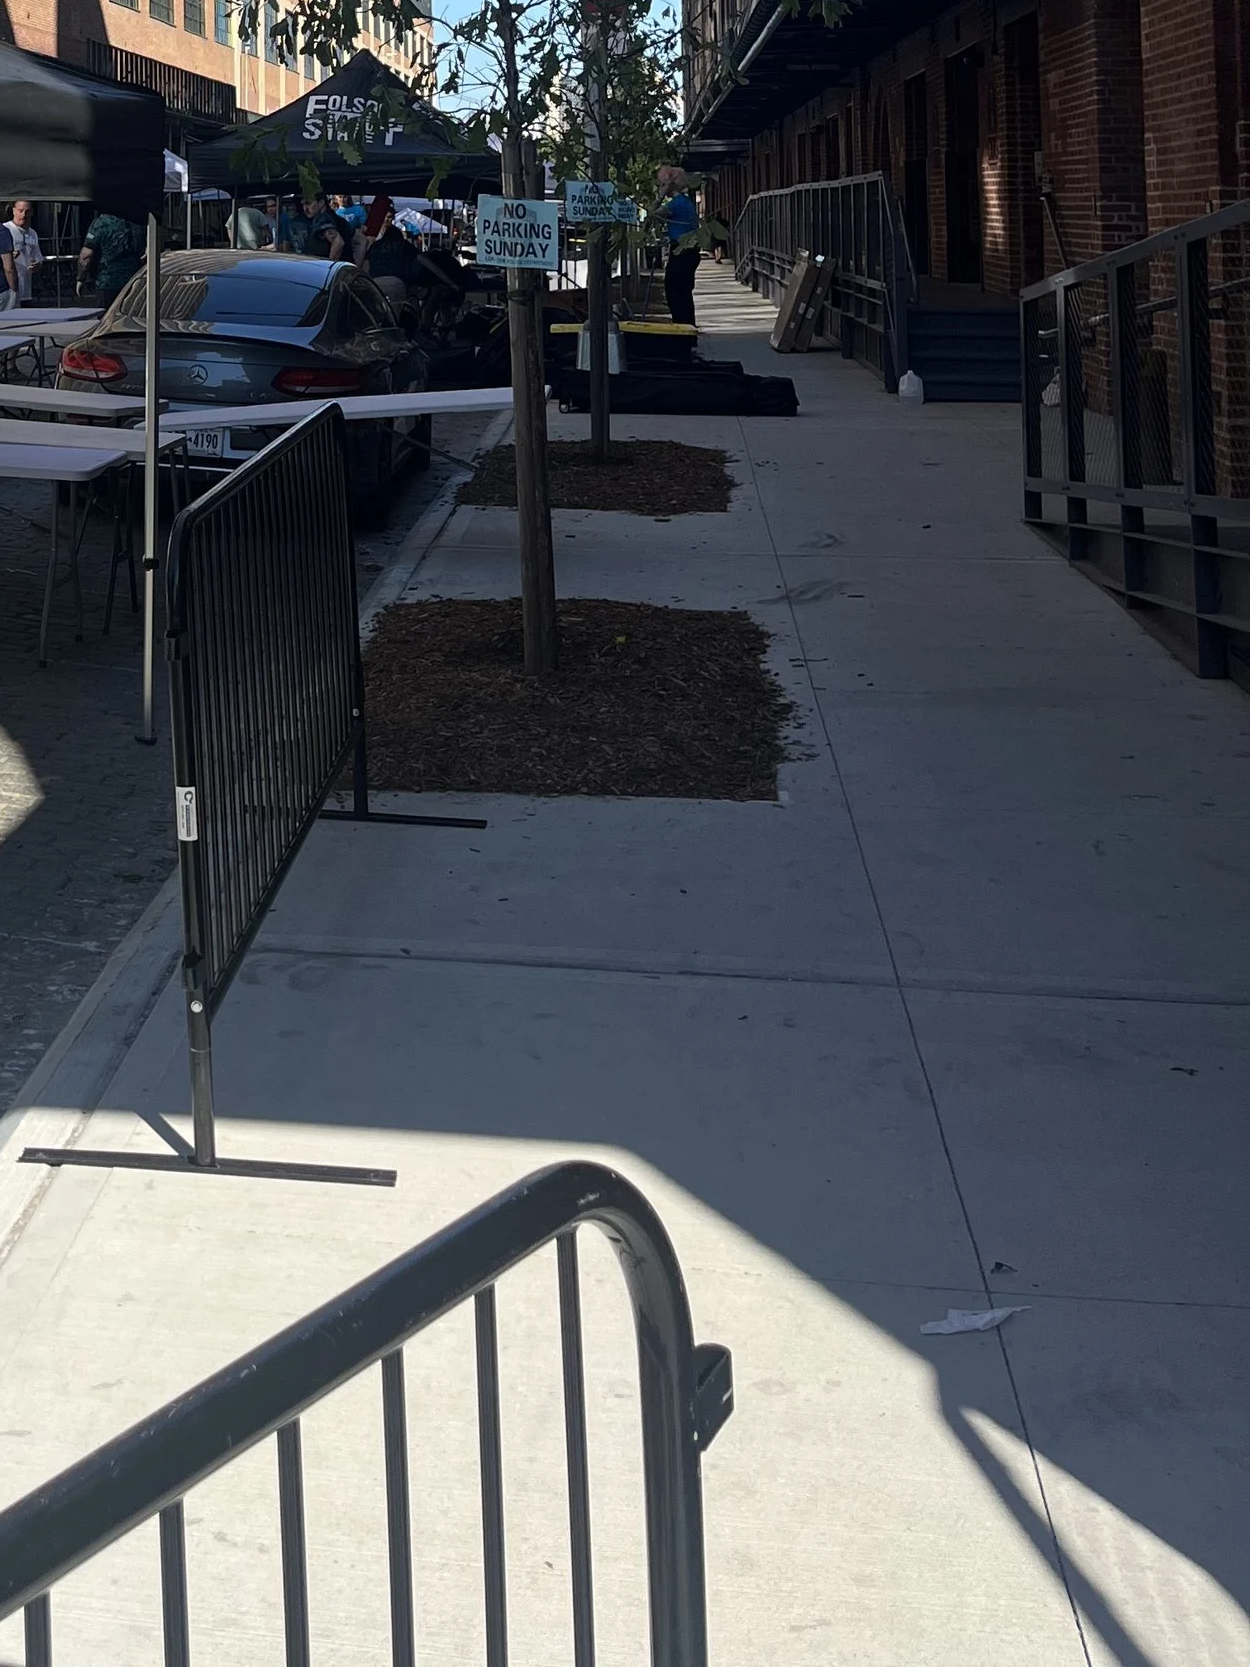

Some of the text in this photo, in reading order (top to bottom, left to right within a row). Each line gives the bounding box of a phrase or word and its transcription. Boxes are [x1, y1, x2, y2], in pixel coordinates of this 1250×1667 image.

[571, 194, 614, 205] PARKING
[503, 202, 527, 220] NO
[482, 218, 552, 240] PARKING
[484, 238, 550, 259] SUNDAY
[193, 432, 219, 449] 4190
